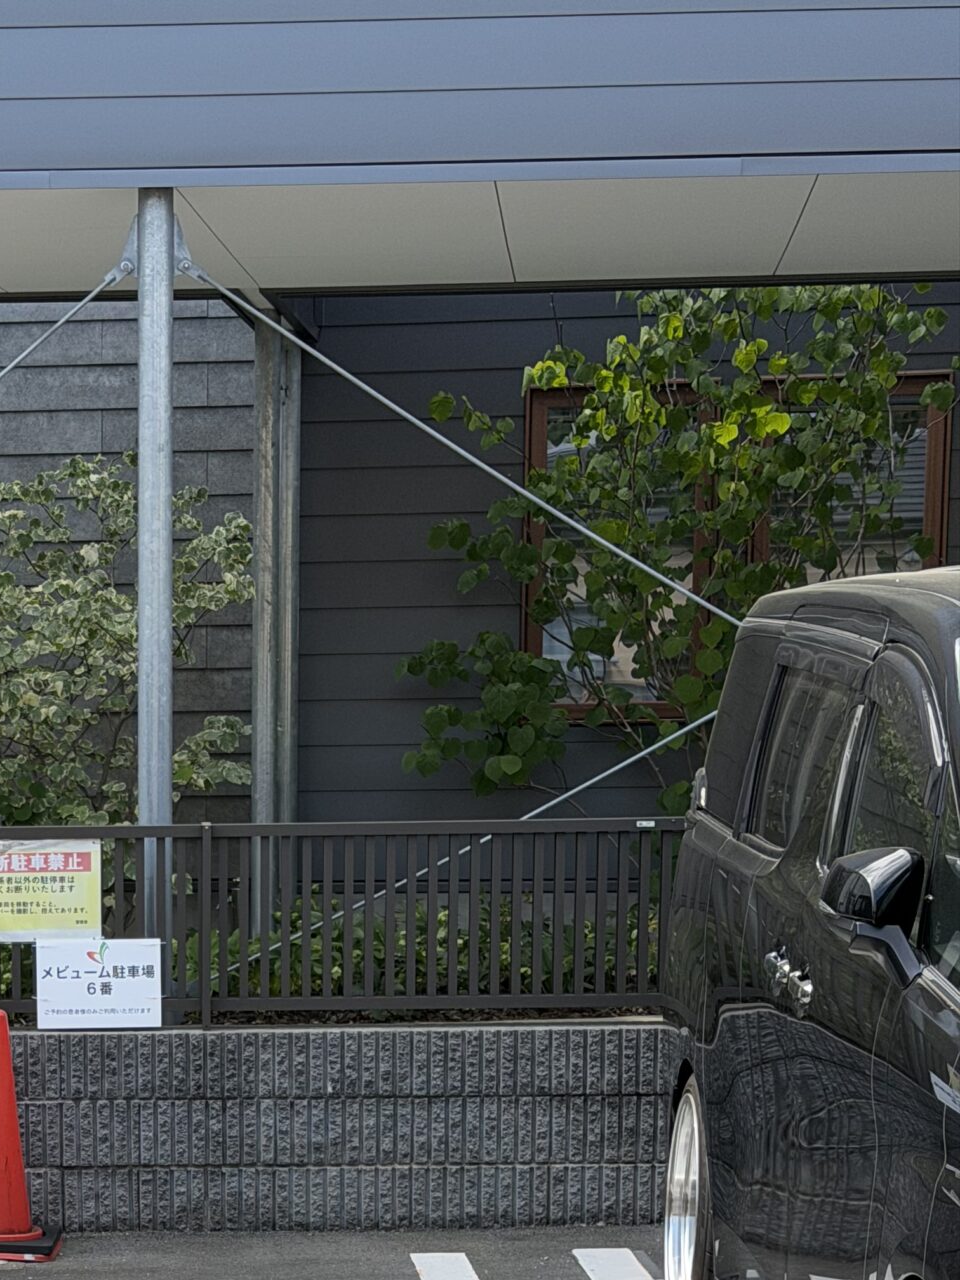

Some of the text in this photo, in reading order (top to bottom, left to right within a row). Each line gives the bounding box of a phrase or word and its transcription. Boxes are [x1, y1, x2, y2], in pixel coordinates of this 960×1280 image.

[41, 964, 155, 980] メビューム駐車場
[87, 981, 113, 996] 6番
